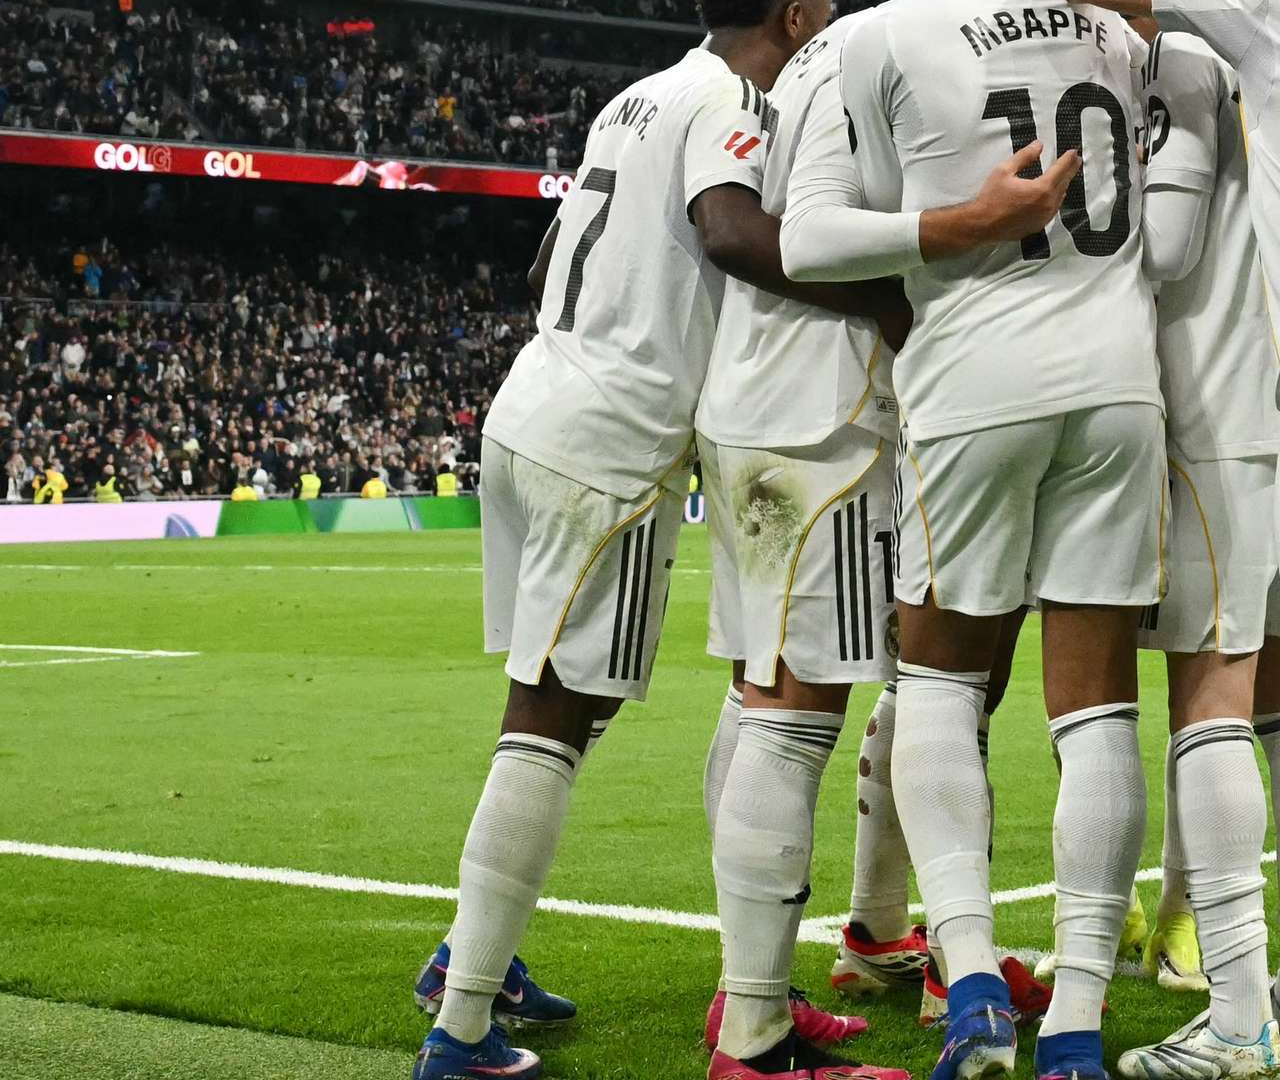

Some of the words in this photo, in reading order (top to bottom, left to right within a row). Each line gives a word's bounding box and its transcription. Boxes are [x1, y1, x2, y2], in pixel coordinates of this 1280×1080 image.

[959, 7, 1108, 57] MBAPPÉ
[203, 150, 261, 179] GOL
[538, 175, 576, 199] GO
[981, 81, 1132, 261] 10
[553, 167, 616, 333] 7
